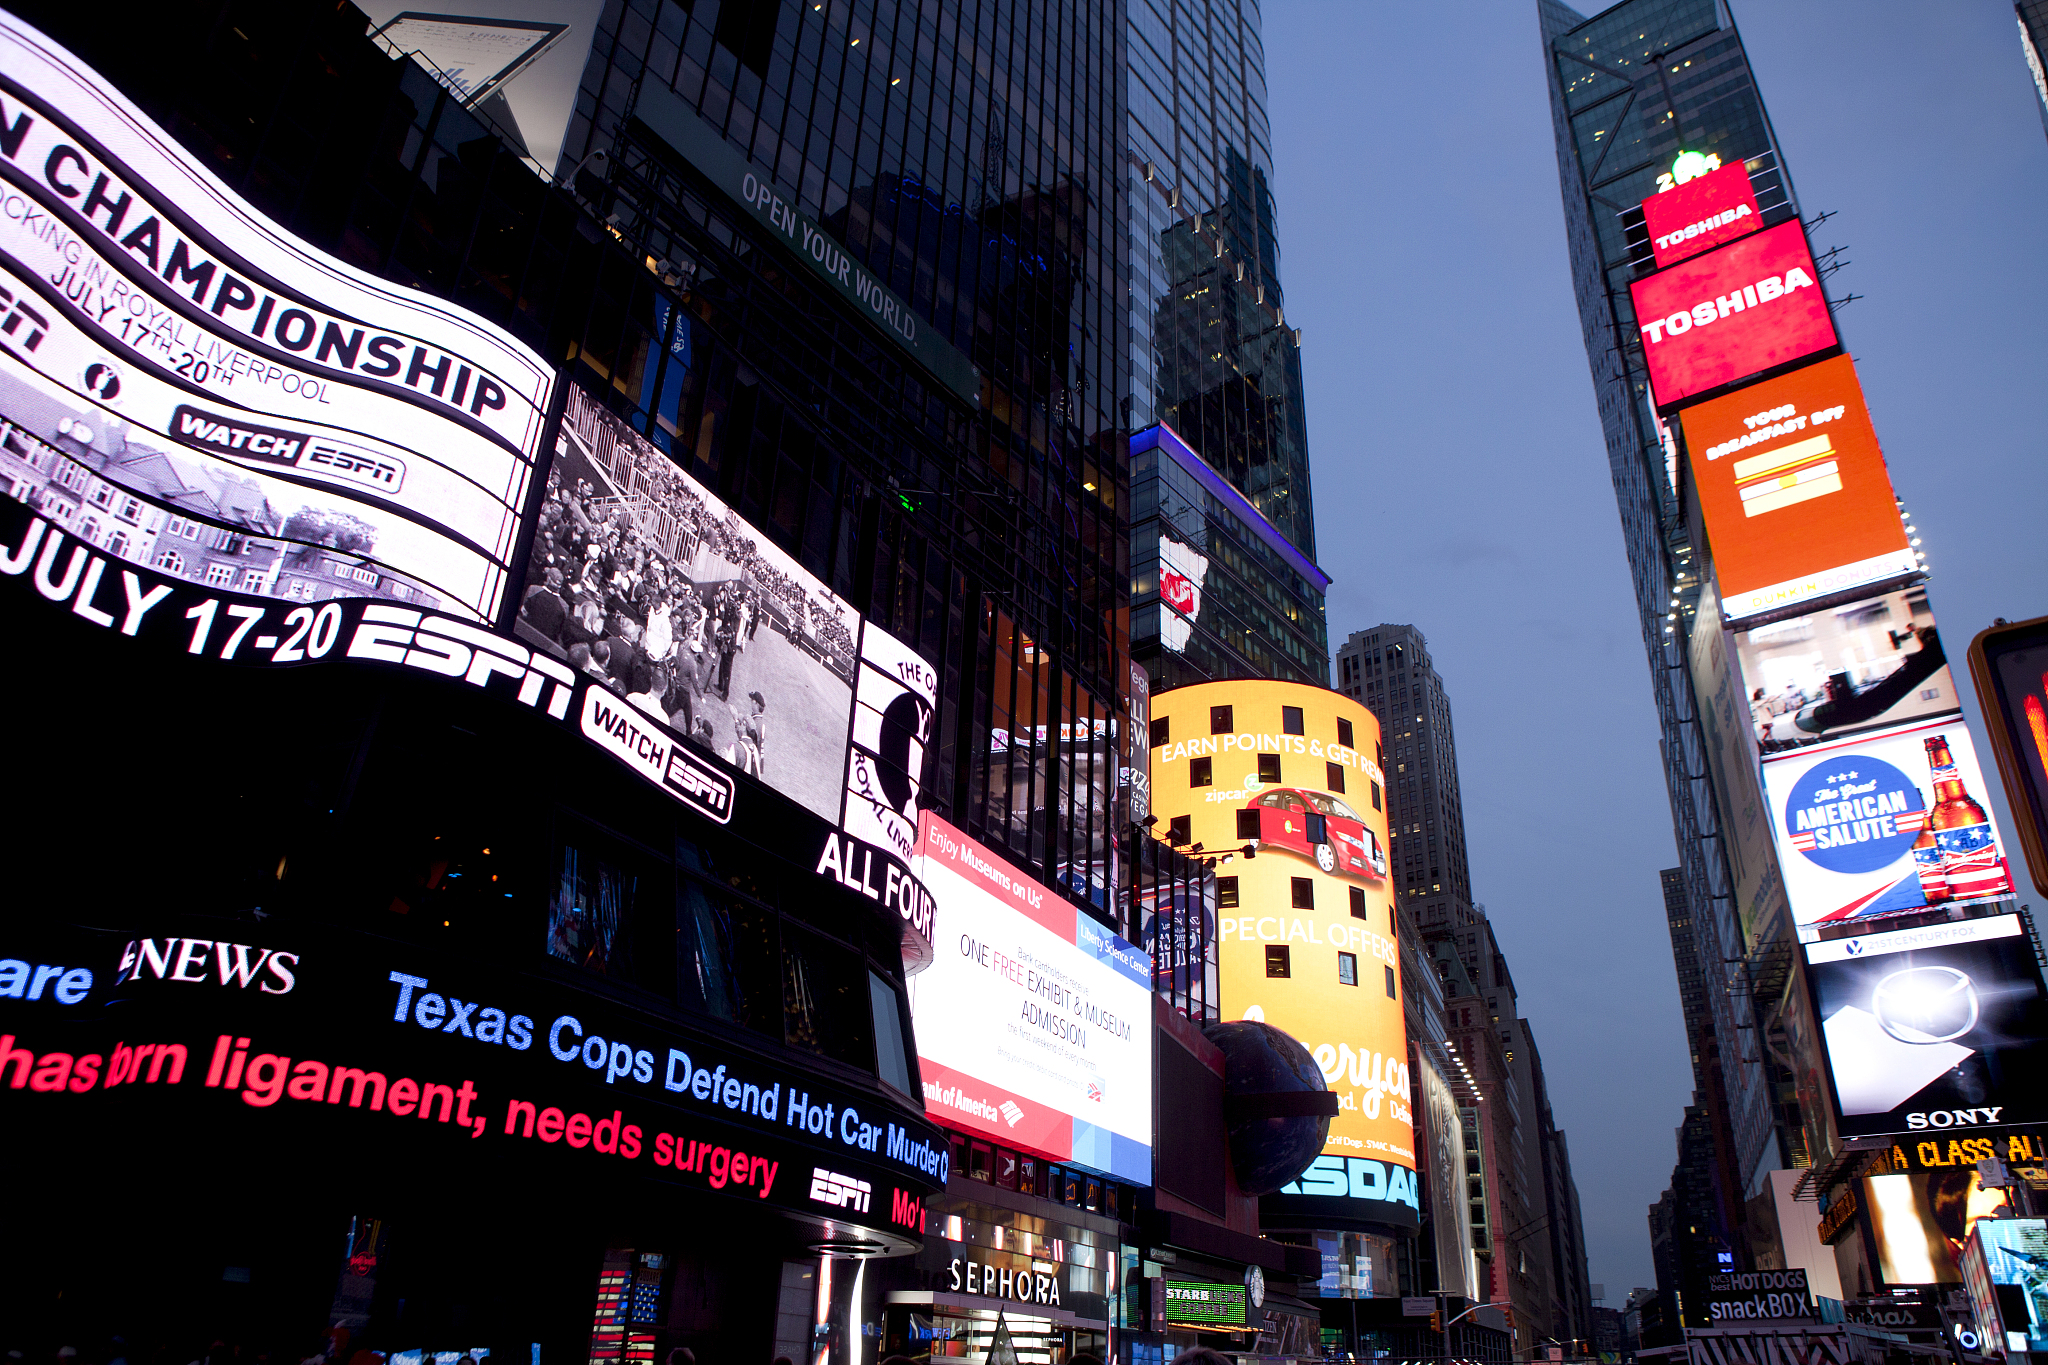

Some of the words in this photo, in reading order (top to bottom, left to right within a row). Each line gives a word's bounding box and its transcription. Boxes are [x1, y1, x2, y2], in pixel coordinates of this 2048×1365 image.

[1655, 203, 1752, 250] TOSHIBA
[45, 144, 506, 417] CHAMPIONSHIP
[742, 172, 796, 238] OPEN
[802, 222, 851, 287] YOUR
[855, 268, 918, 347] WORLD.
[51, 266, 116, 323] JULY
[1641, 266, 1814, 344] TOSHIBA
[85, 257, 109, 289] IN
[111, 280, 186, 346] ROYAL
[194, 333, 330, 404] LIVERPOOL
[1706, 415, 1807, 461] BREAKFAST
[1810, 404, 1845, 426] BFF
[1743, 403, 1797, 430] YOUR
[180, 413, 300, 459] WATCH
[309, 446, 397, 484] ESPN
[1824, 561, 1893, 588] DONUTS
[0, 516, 174, 637] JULY
[185, 598, 342, 662] 17-20
[346, 604, 576, 721] ESPN
[897, 661, 921, 683] THE
[594, 700, 665, 770] WATCH
[668, 755, 728, 810] ESPN
[1162, 736, 1217, 763] EARN
[1223, 733, 1306, 755] POINTS
[1310, 739, 1325, 758] &
[1327, 744, 1358, 768] GET
[1796, 790, 1908, 832] AMERICAN
[1814, 788, 1840, 803] The
[1840, 779, 1877, 801] Great
[1814, 815, 1898, 850] SALUTE
[816, 832, 879, 900] ALL
[929, 824, 959, 862] Enjoy
[960, 843, 1011, 890] Museums
[1012, 878, 1027, 901] on
[1080, 922, 1104, 954] Liberty
[1105, 940, 1128, 969] Science
[1129, 955, 1150, 978] Center
[1327, 923, 1396, 967] OFFERS
[1868, 937, 1893, 951] 21ST
[1893, 929, 1949, 948] CENTURY
[1951, 926, 1977, 938] FOX
[960, 933, 990, 969] ONE
[993, 950, 1025, 987] FREE
[1028, 969, 1071, 1010] EXHIBIT
[1074, 996, 1083, 1018] &
[1085, 1001, 1131, 1043] MUSEUM
[1017, 946, 1034, 965] Bank
[1034, 958, 1069, 986] cardholders
[1069, 978, 1089, 996] receive
[1007, 1021, 1018, 1036] the
[1019, 1025, 1031, 1042] first
[1032, 1035, 1057, 1054] weekend
[1057, 1045, 1064, 1056] of
[1064, 1050, 1079, 1067] every
[1079, 1057, 1097, 1072] month
[1021, 1000, 1086, 1050] ADMISSION
[129, 937, 300, 995] NEWS
[388, 970, 535, 1051] Texas
[548, 1015, 655, 1084] Cops
[664, 1048, 780, 1121] Defend
[786, 1088, 835, 1139] Hot
[840, 1107, 883, 1152] Car
[886, 1123, 940, 1177] Murder
[0, 1034, 103, 1093] has
[204, 1034, 488, 1139] ligament,
[504, 1098, 643, 1159] needs
[653, 1131, 779, 1200] surgery
[809, 1167, 872, 1215] ESPN
[954, 1094, 998, 1123] America
[1905, 1106, 2003, 1130] SONY
[1343, 1136, 1363, 1149] Dogs
[1892, 1144, 1909, 1170] A
[1917, 1138, 1995, 1167] CLASS
[948, 1257, 1061, 1307] SEPHORA
[1166, 1288, 1243, 1304] STARBUCKS
[1710, 1282, 1731, 1291] best
[1730, 1272, 1760, 1291] HOT
[1761, 1270, 1806, 1290] DOGS
[1179, 1302, 1228, 1316] COFFEE
[1709, 1291, 1812, 1320] snackBOX
[1042, 1336, 1064, 1344] SEPHORA
